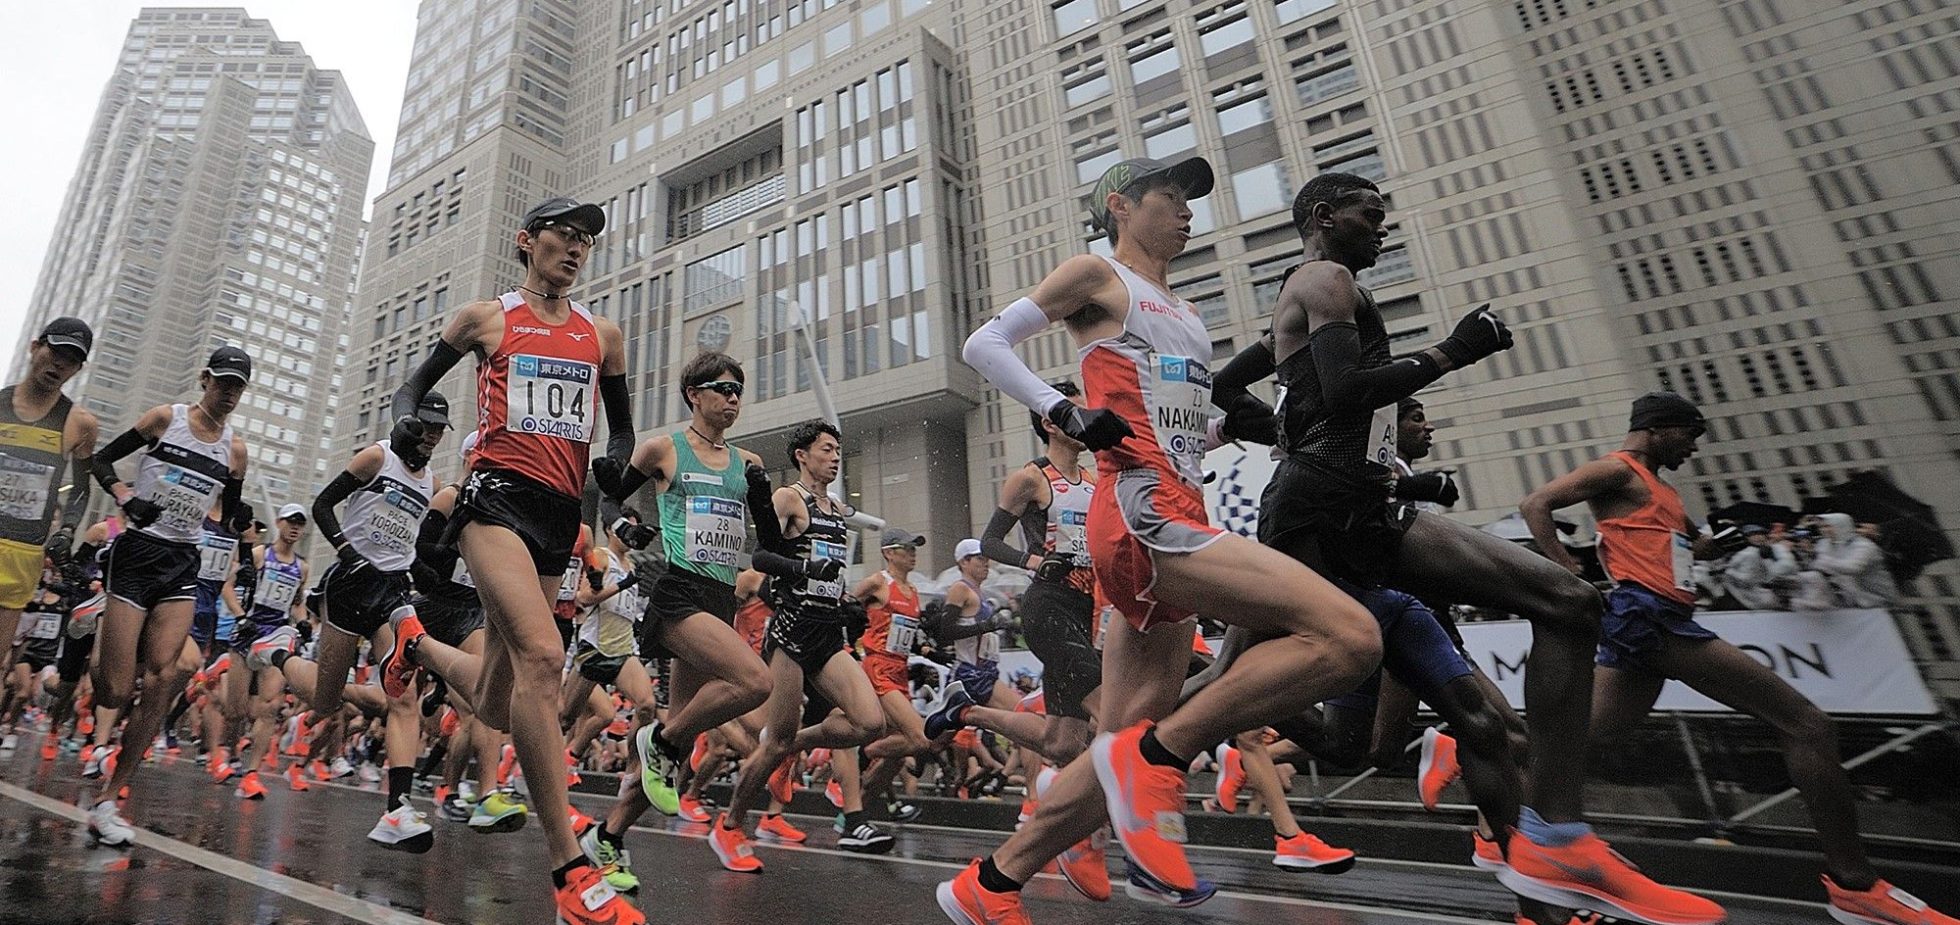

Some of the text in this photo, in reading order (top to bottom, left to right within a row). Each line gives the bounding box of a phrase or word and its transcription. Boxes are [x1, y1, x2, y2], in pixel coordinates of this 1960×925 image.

[540, 363, 589, 379] 東京メトロ
[527, 381, 585, 423] 104
[1193, 388, 1203, 407] 23
[388, 510, 409, 526] PACE
[717, 518, 730, 531] 28
[695, 531, 742, 551] KAMINO
